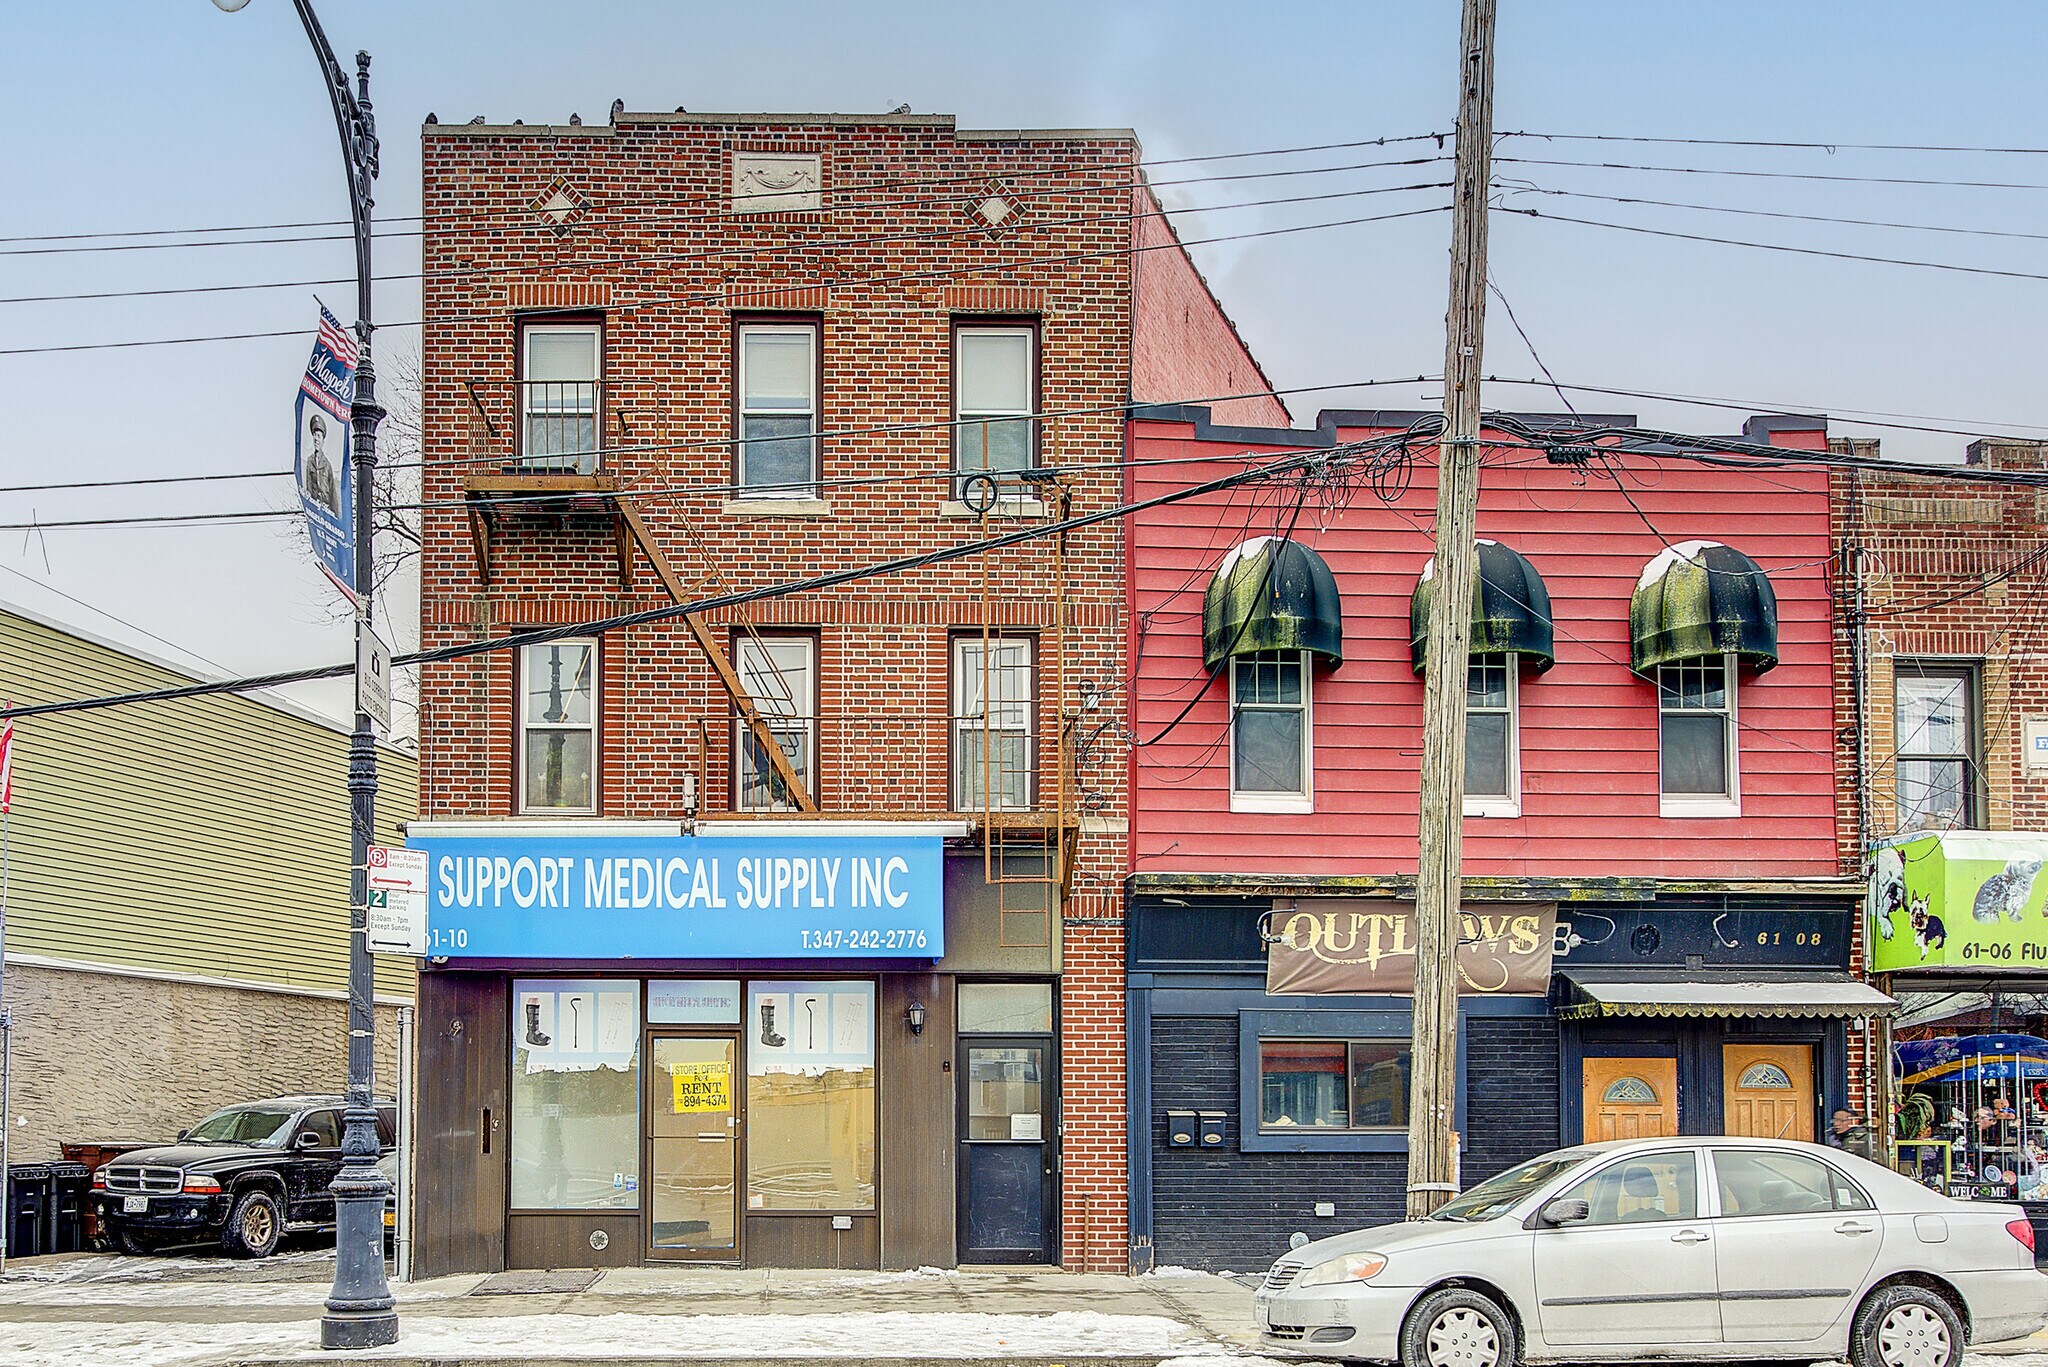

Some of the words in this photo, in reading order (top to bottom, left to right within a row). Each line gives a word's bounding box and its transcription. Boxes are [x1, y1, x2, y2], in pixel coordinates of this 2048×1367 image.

[302, 378, 335, 410] HOMETOWN
[389, 862, 405, 870] Except
[406, 863, 423, 871] Sunday
[438, 855, 574, 909] SUPPORT
[584, 856, 727, 910] MEDICAL
[736, 856, 843, 910] SUPPLY
[851, 856, 910, 909] INC
[372, 890, 383, 907] 2
[371, 914, 391, 923] 8:30am
[397, 916, 409, 925] 7pm
[371, 922, 390, 931] Except
[391, 924, 412, 933] Sunday
[801, 929, 928, 950] T.347-242-2776
[1284, 911, 1541, 970] OUTLWS
[1757, 931, 1781, 946] 61
[1795, 931, 1822, 946] 08
[1962, 942, 2012, 960] 61-06
[681, 1082, 722, 1095] RENT
[684, 1094, 727, 1108] 894-4374
